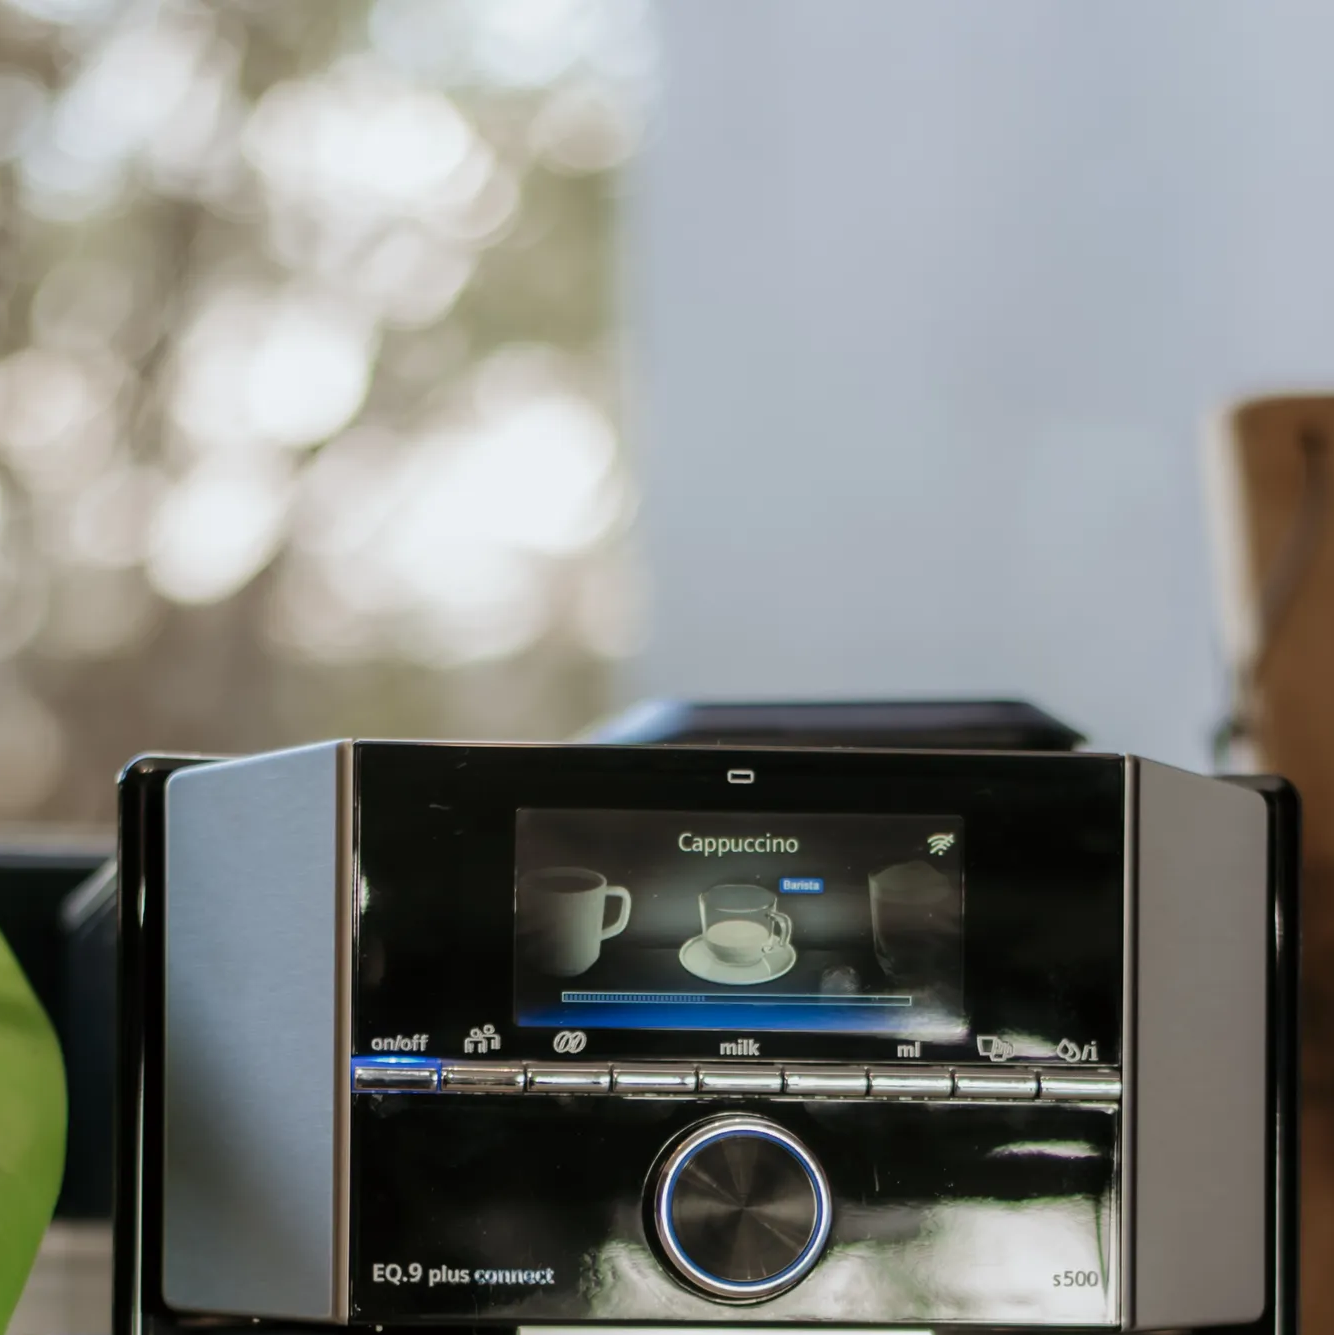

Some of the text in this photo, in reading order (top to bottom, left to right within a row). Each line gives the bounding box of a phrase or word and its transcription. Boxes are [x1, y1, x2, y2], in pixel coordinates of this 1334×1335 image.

[678, 832, 799, 857] Cappuccino
[782, 879, 821, 891] Barista
[370, 1034, 430, 1052] on/off
[719, 1038, 761, 1057] milk
[896, 1041, 921, 1058] ml
[372, 1262, 555, 1287] EQ.9 plus connect
[1052, 1270, 1099, 1288] s500
